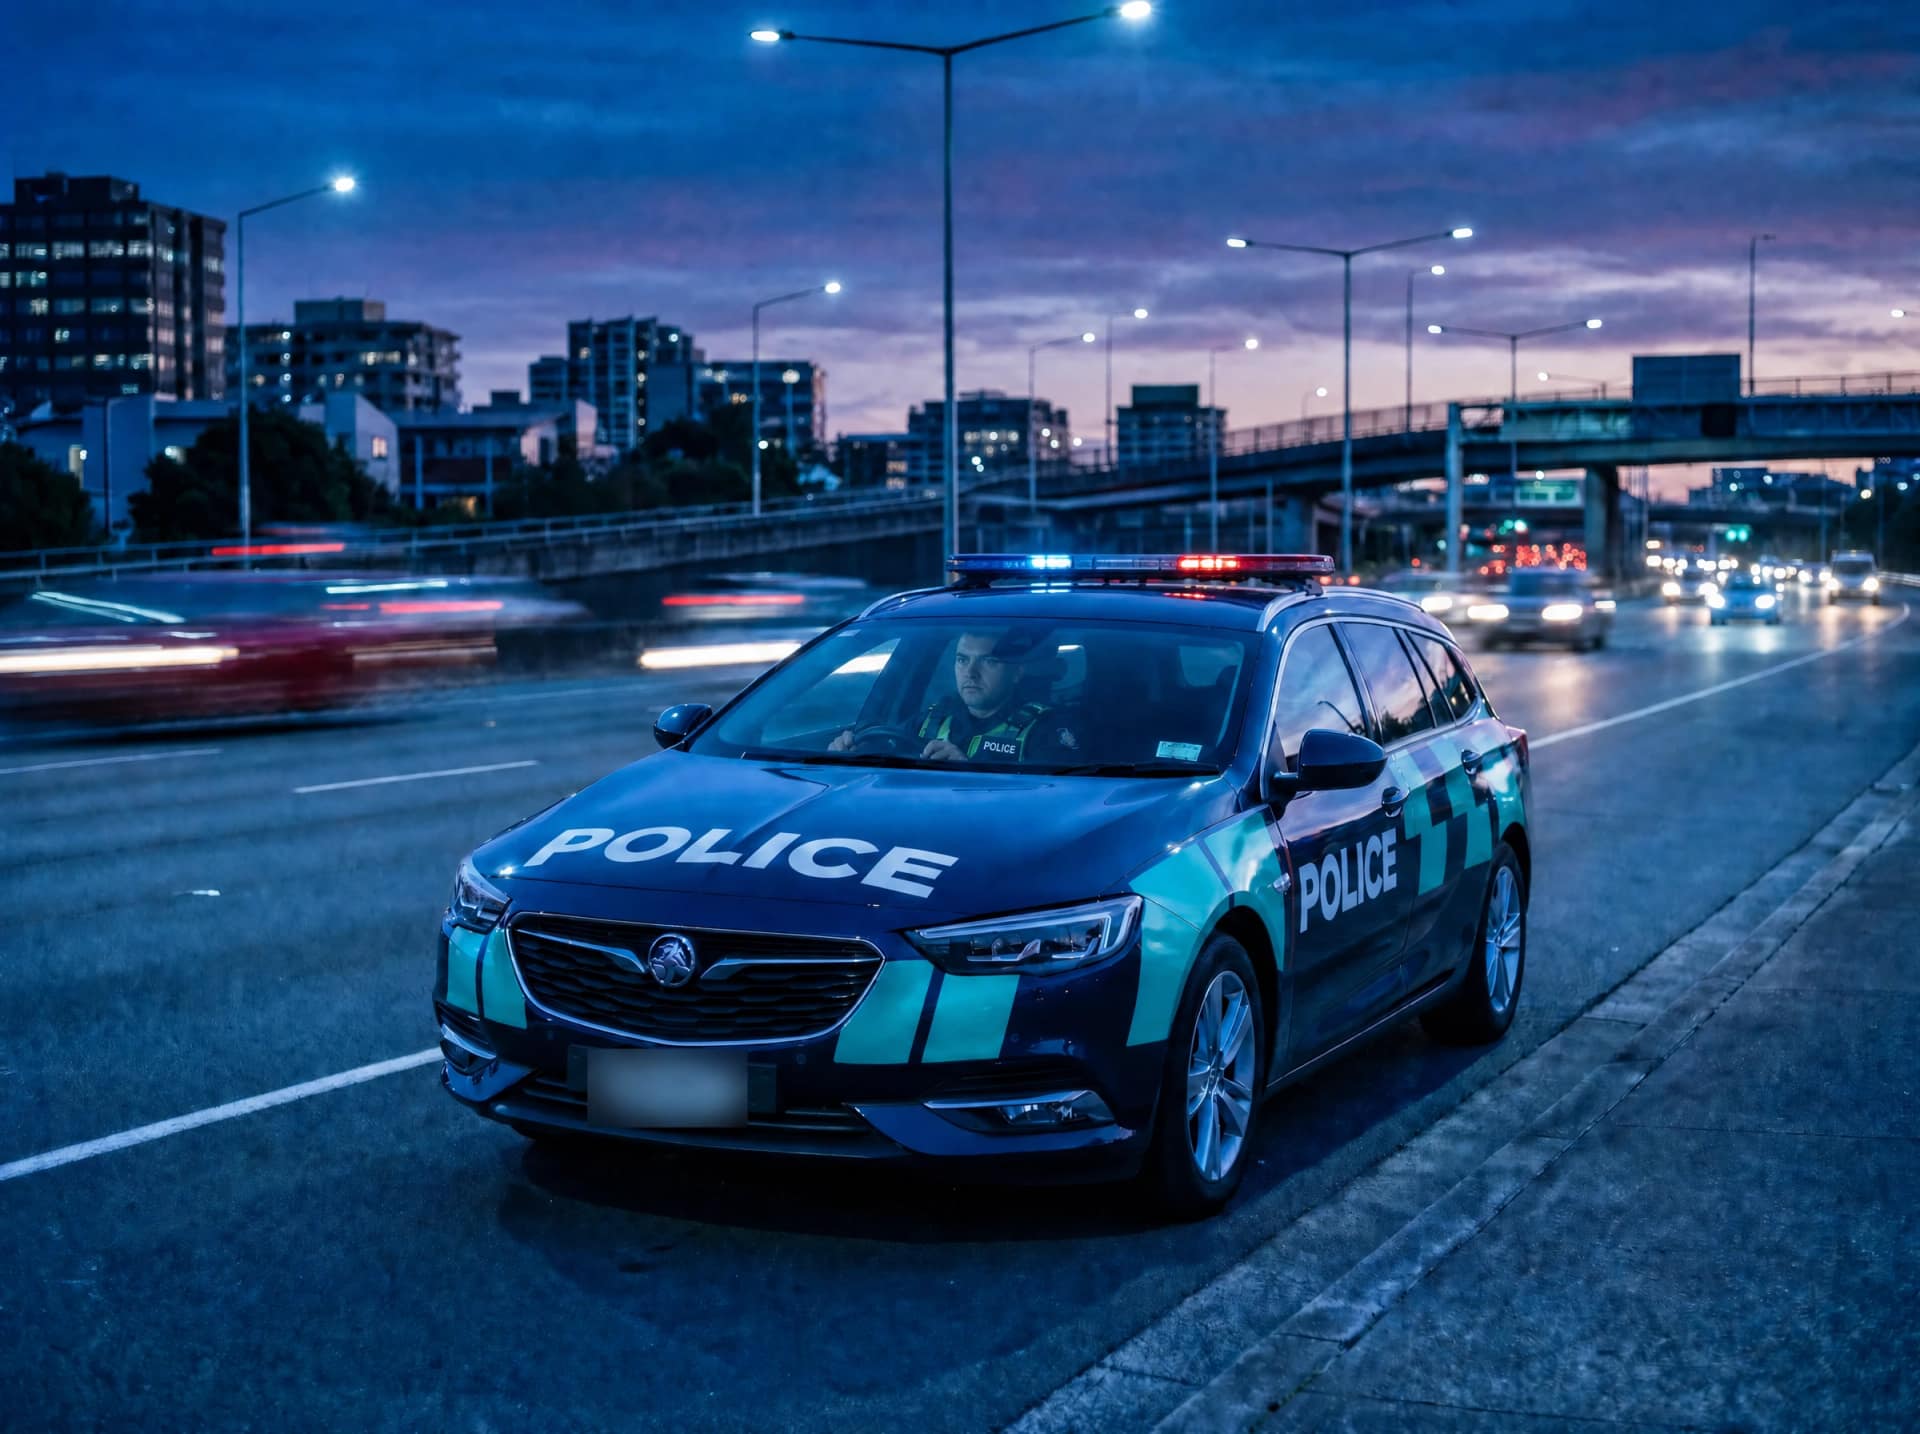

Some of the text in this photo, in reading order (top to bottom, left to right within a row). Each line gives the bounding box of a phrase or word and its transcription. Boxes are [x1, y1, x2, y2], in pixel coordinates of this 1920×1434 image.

[983, 741, 1016, 754] POLICE
[523, 826, 959, 898] POLICE
[1299, 827, 1397, 934] POLICE
